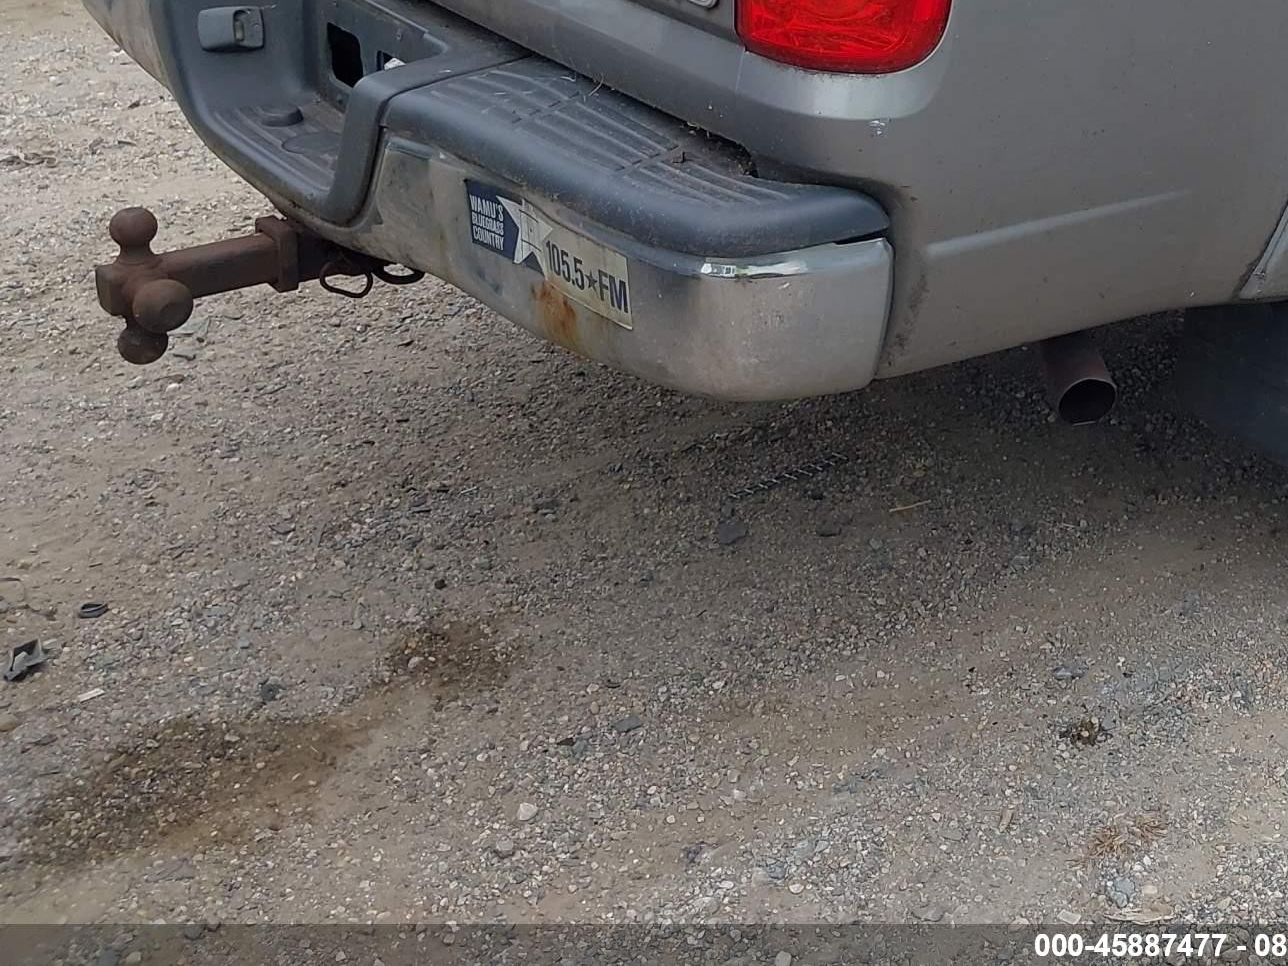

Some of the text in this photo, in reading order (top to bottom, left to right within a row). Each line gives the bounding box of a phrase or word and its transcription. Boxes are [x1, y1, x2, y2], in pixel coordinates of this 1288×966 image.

[469, 193, 504, 222] WAMU'S
[471, 211, 504, 236] BLUEGRASS
[473, 225, 505, 251] COUNTRY
[546, 240, 630, 314] 105.5 FM
